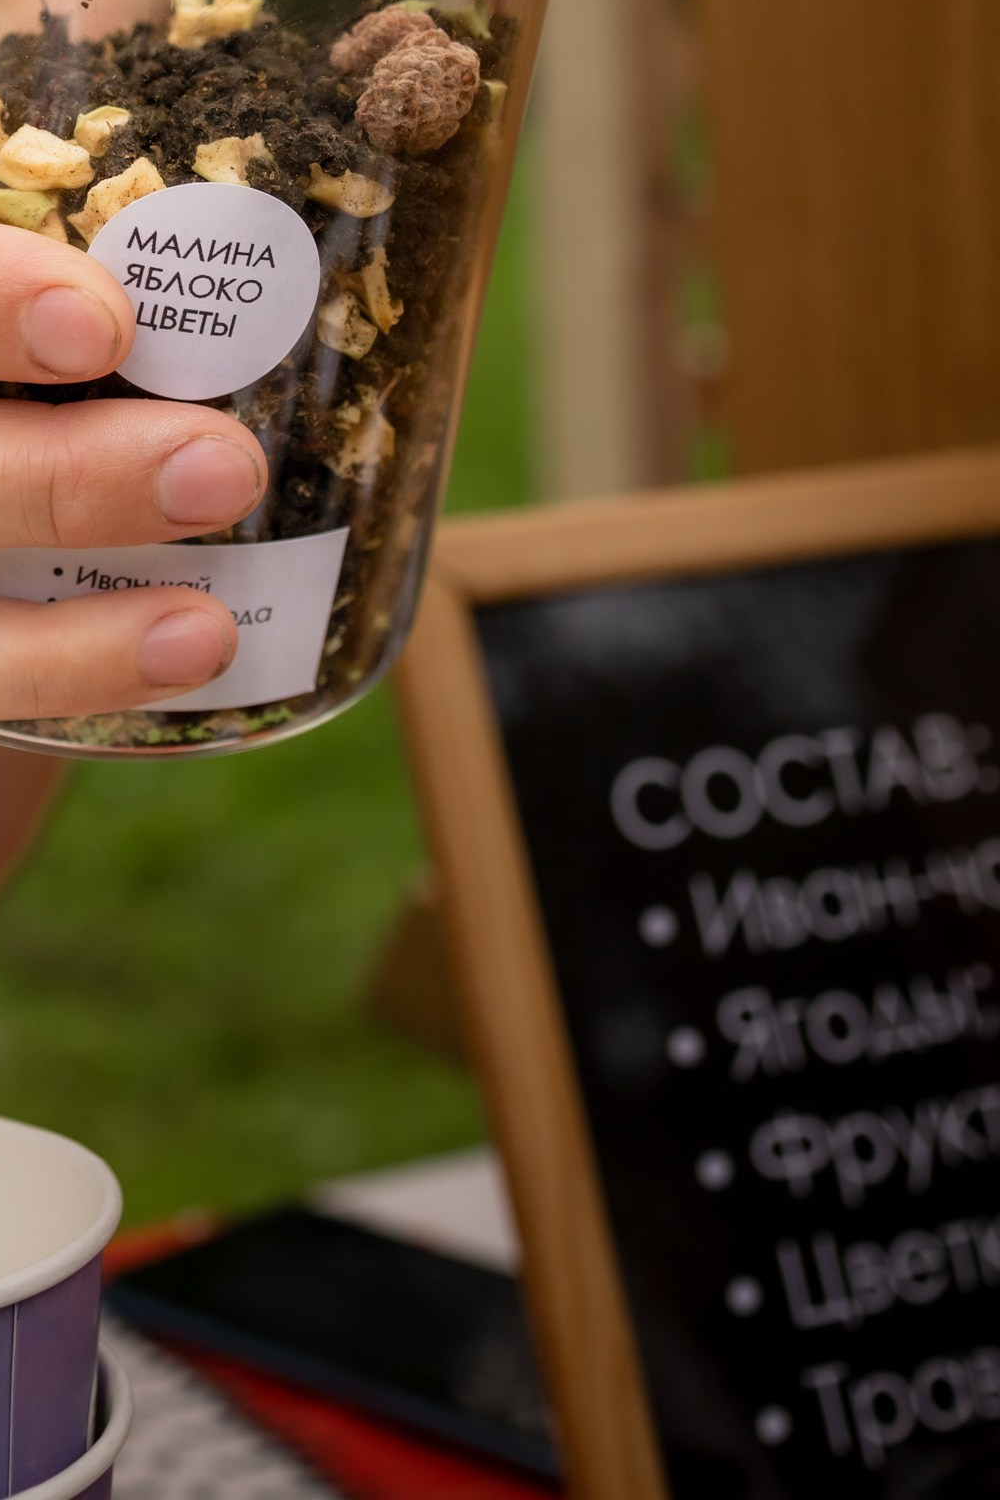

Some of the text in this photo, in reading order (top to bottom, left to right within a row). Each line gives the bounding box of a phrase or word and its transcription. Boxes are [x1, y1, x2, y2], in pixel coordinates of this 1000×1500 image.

[126, 226, 275, 268] МАЛИНА
[123, 263, 263, 304] ЯБЛОКО
[136, 301, 237, 338] ЦВЕТЫ
[610, 711, 998, 852] СОСТАВ:
